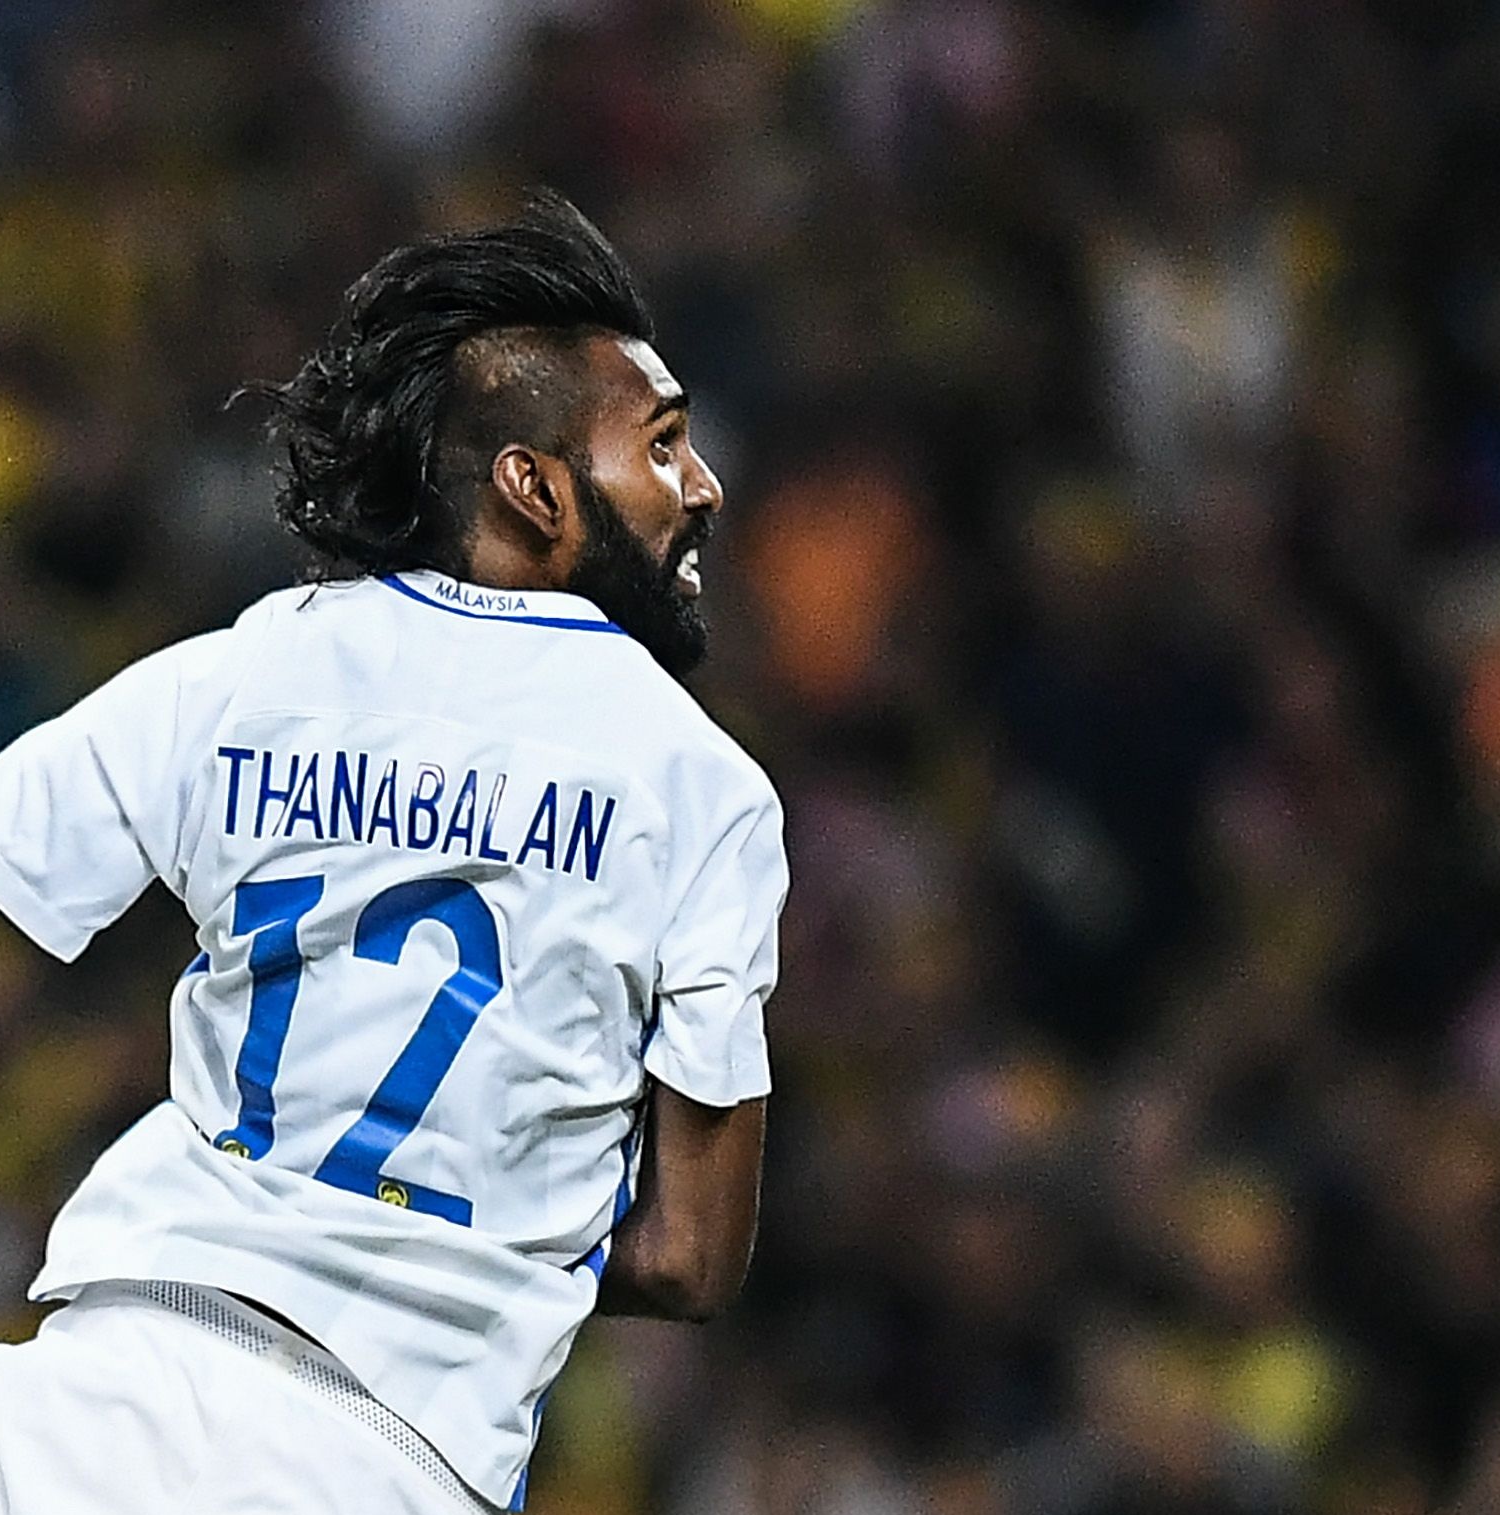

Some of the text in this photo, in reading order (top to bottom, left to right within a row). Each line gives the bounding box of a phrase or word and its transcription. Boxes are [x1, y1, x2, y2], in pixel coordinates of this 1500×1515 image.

[435, 581, 527, 611] MALAYSIA
[217, 746, 616, 881] THANABALAN
[214, 874, 503, 1228] 12
